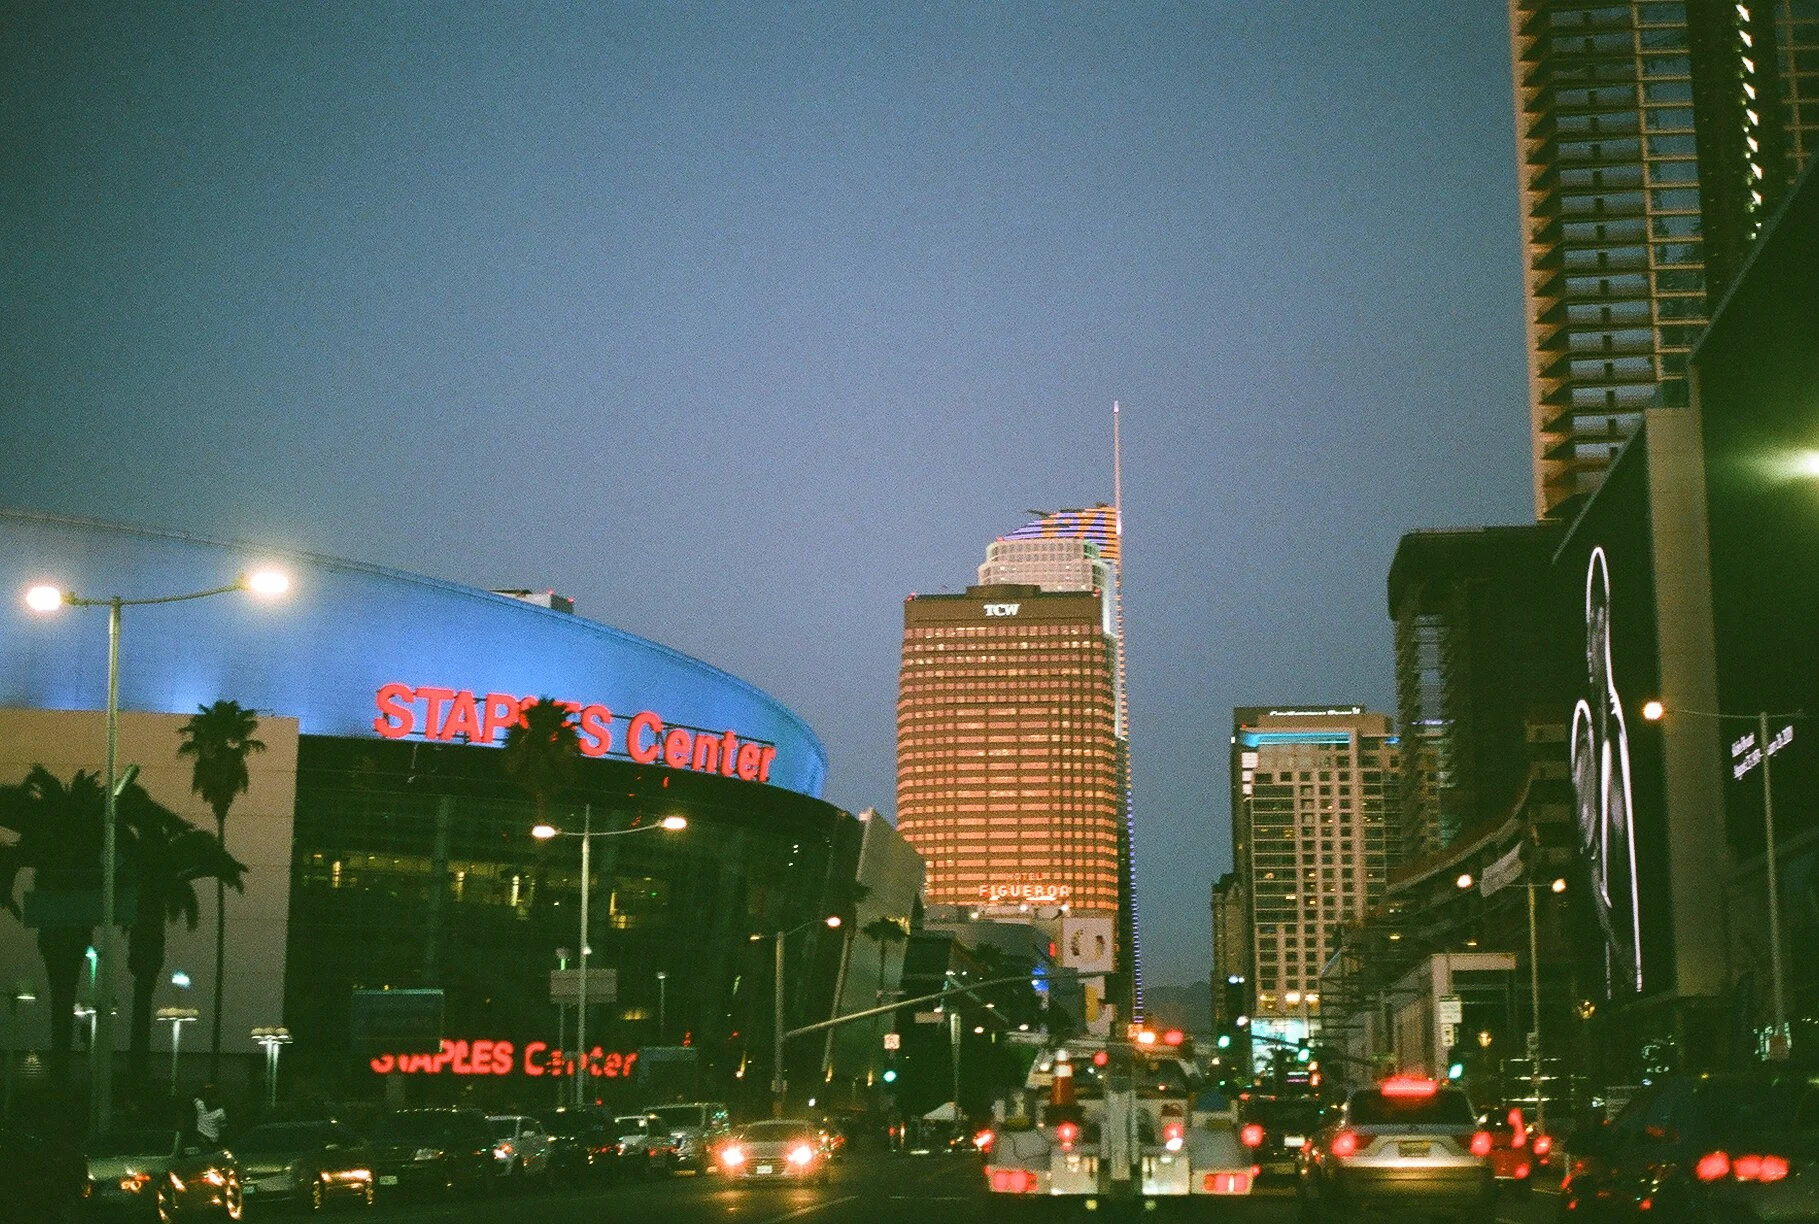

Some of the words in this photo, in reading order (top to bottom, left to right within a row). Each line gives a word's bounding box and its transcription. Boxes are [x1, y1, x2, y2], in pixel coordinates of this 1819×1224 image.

[983, 603, 1021, 617] TCW
[373, 683, 613, 758] STAPS
[627, 711, 776, 785] Center
[978, 884, 1070, 897] FIGUEROA
